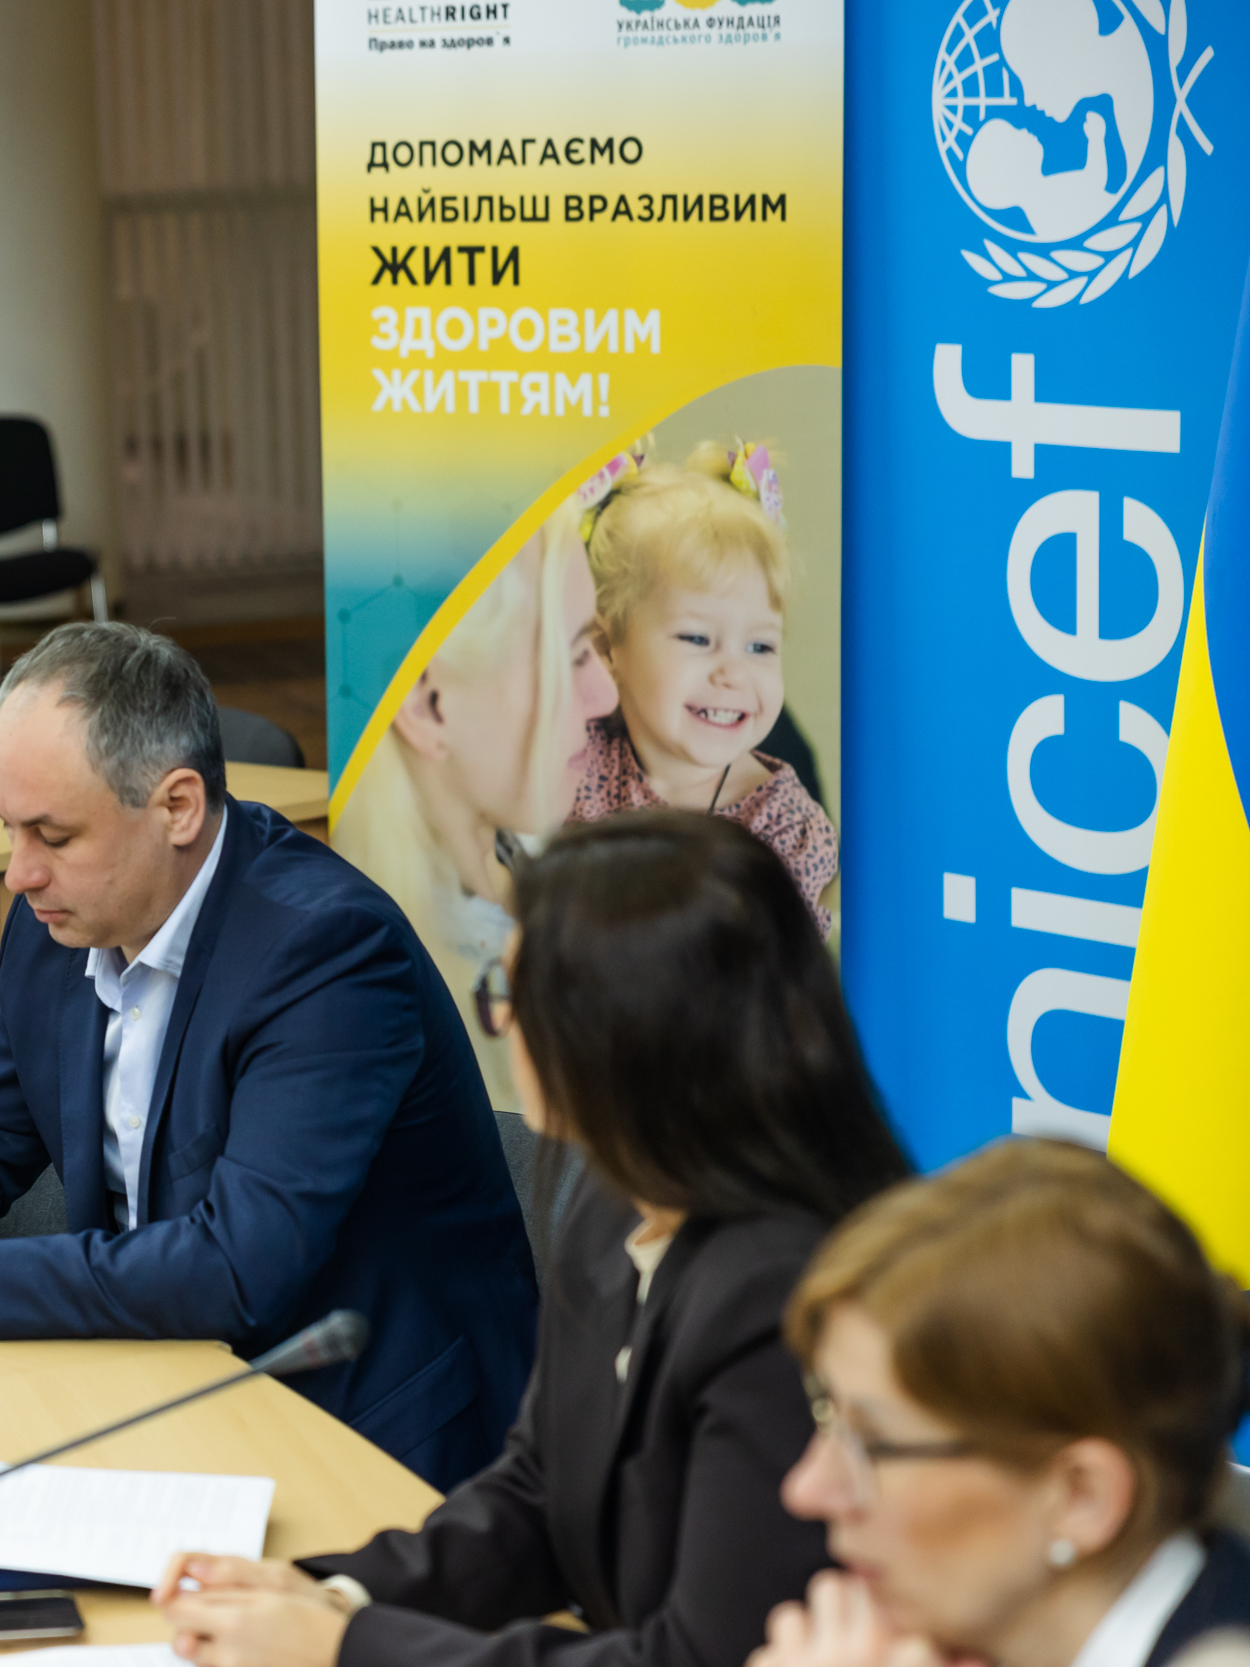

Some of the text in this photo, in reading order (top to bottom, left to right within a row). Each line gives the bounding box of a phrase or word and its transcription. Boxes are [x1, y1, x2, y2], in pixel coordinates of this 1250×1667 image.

[367, 3, 510, 25] HEALTHRIGHT
[617, 14, 781, 33] УКРАЇНСЬКА ФУНДАЦІЯ
[368, 37, 414, 53] Право
[419, 38, 435, 48] на
[617, 32, 712, 48] громадського
[367, 136, 643, 173] ДОПОМАГАЄМО
[369, 188, 787, 223] НАЙБІЛЬШ ВРАЗЛИВИМ
[370, 246, 520, 286] ЖИТИ
[370, 306, 661, 358] ЗДОРОВИМ
[371, 368, 610, 417] ЖИТТЯМ!
[933, 343, 1184, 1152] nicef
